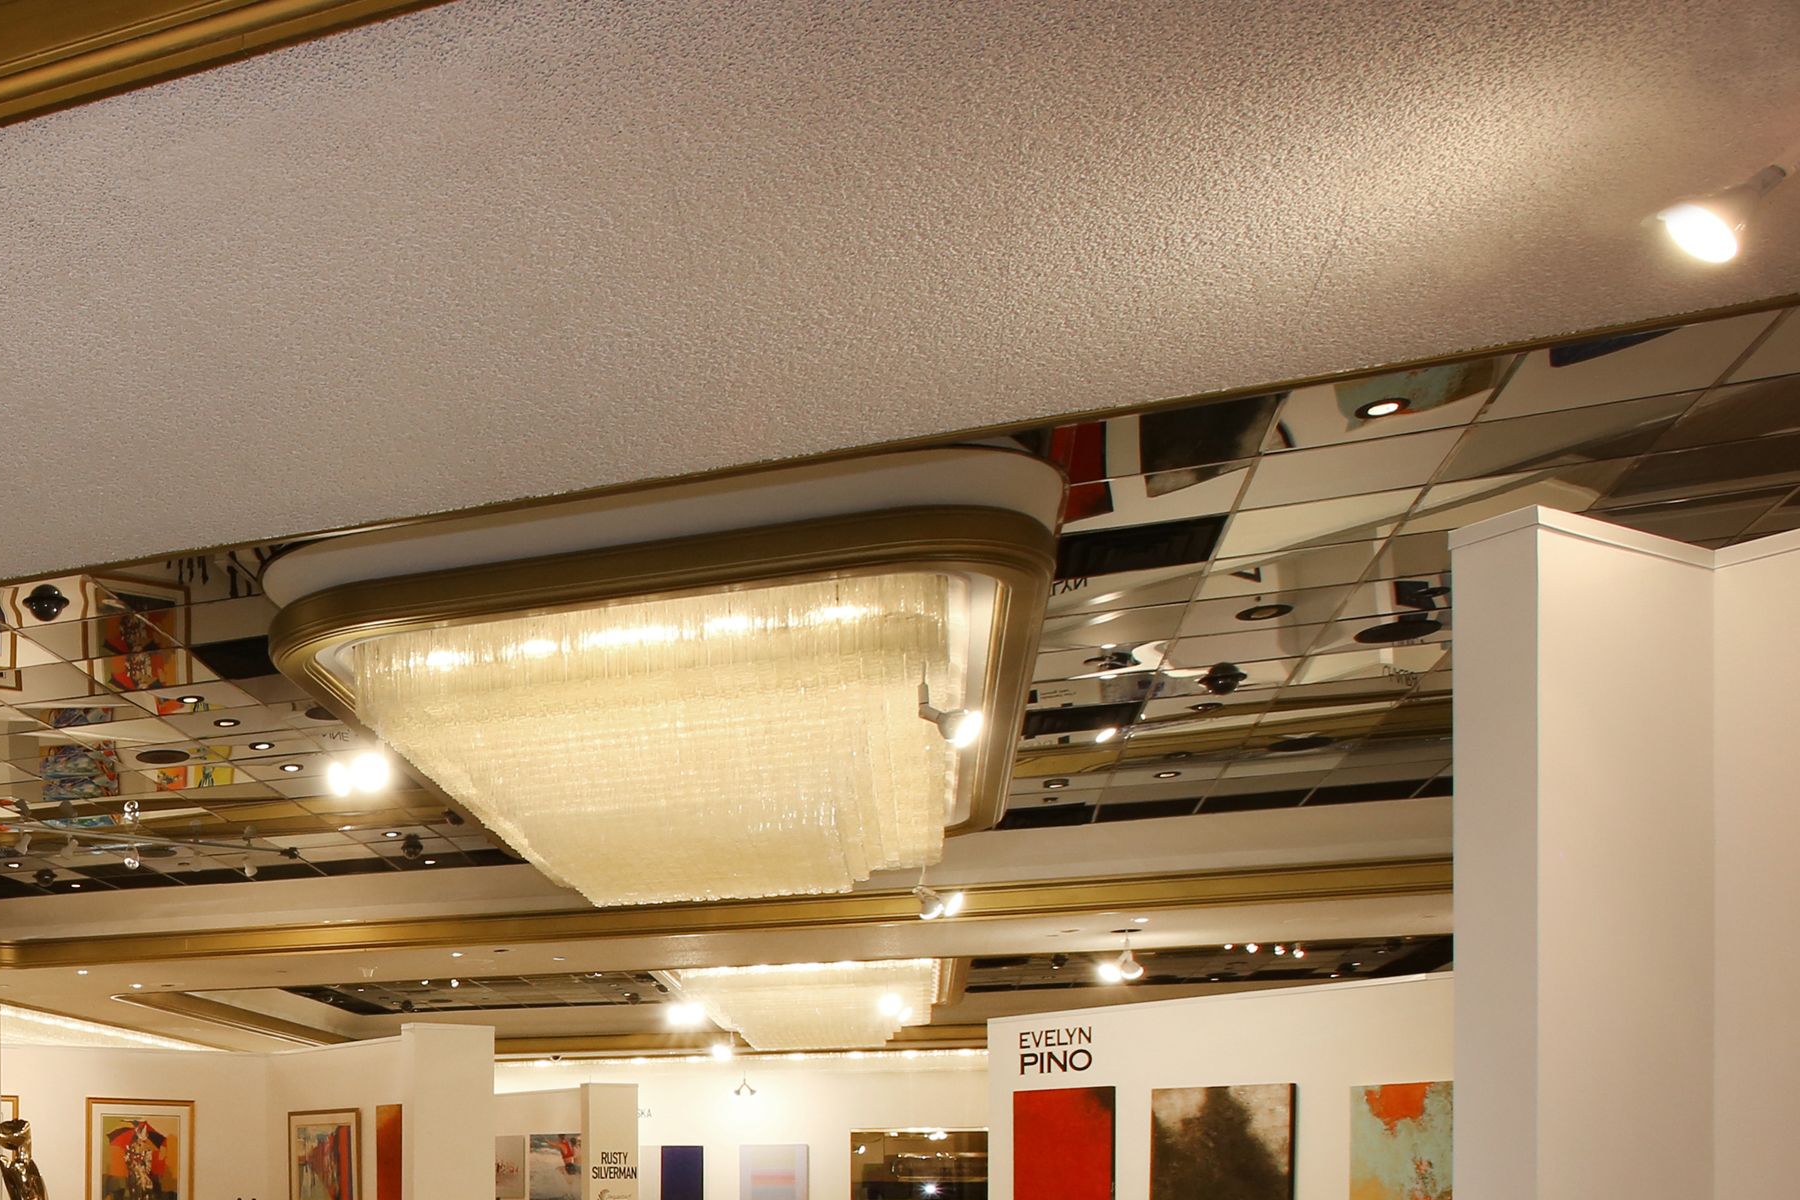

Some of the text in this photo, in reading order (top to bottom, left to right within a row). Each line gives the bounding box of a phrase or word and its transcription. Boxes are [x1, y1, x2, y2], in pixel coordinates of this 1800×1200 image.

[1019, 1026, 1092, 1049] EVELYN
[1019, 1048, 1093, 1076] PINO
[600, 1151, 629, 1165] RUSTY
[591, 1166, 638, 1180] SILVERMAN
